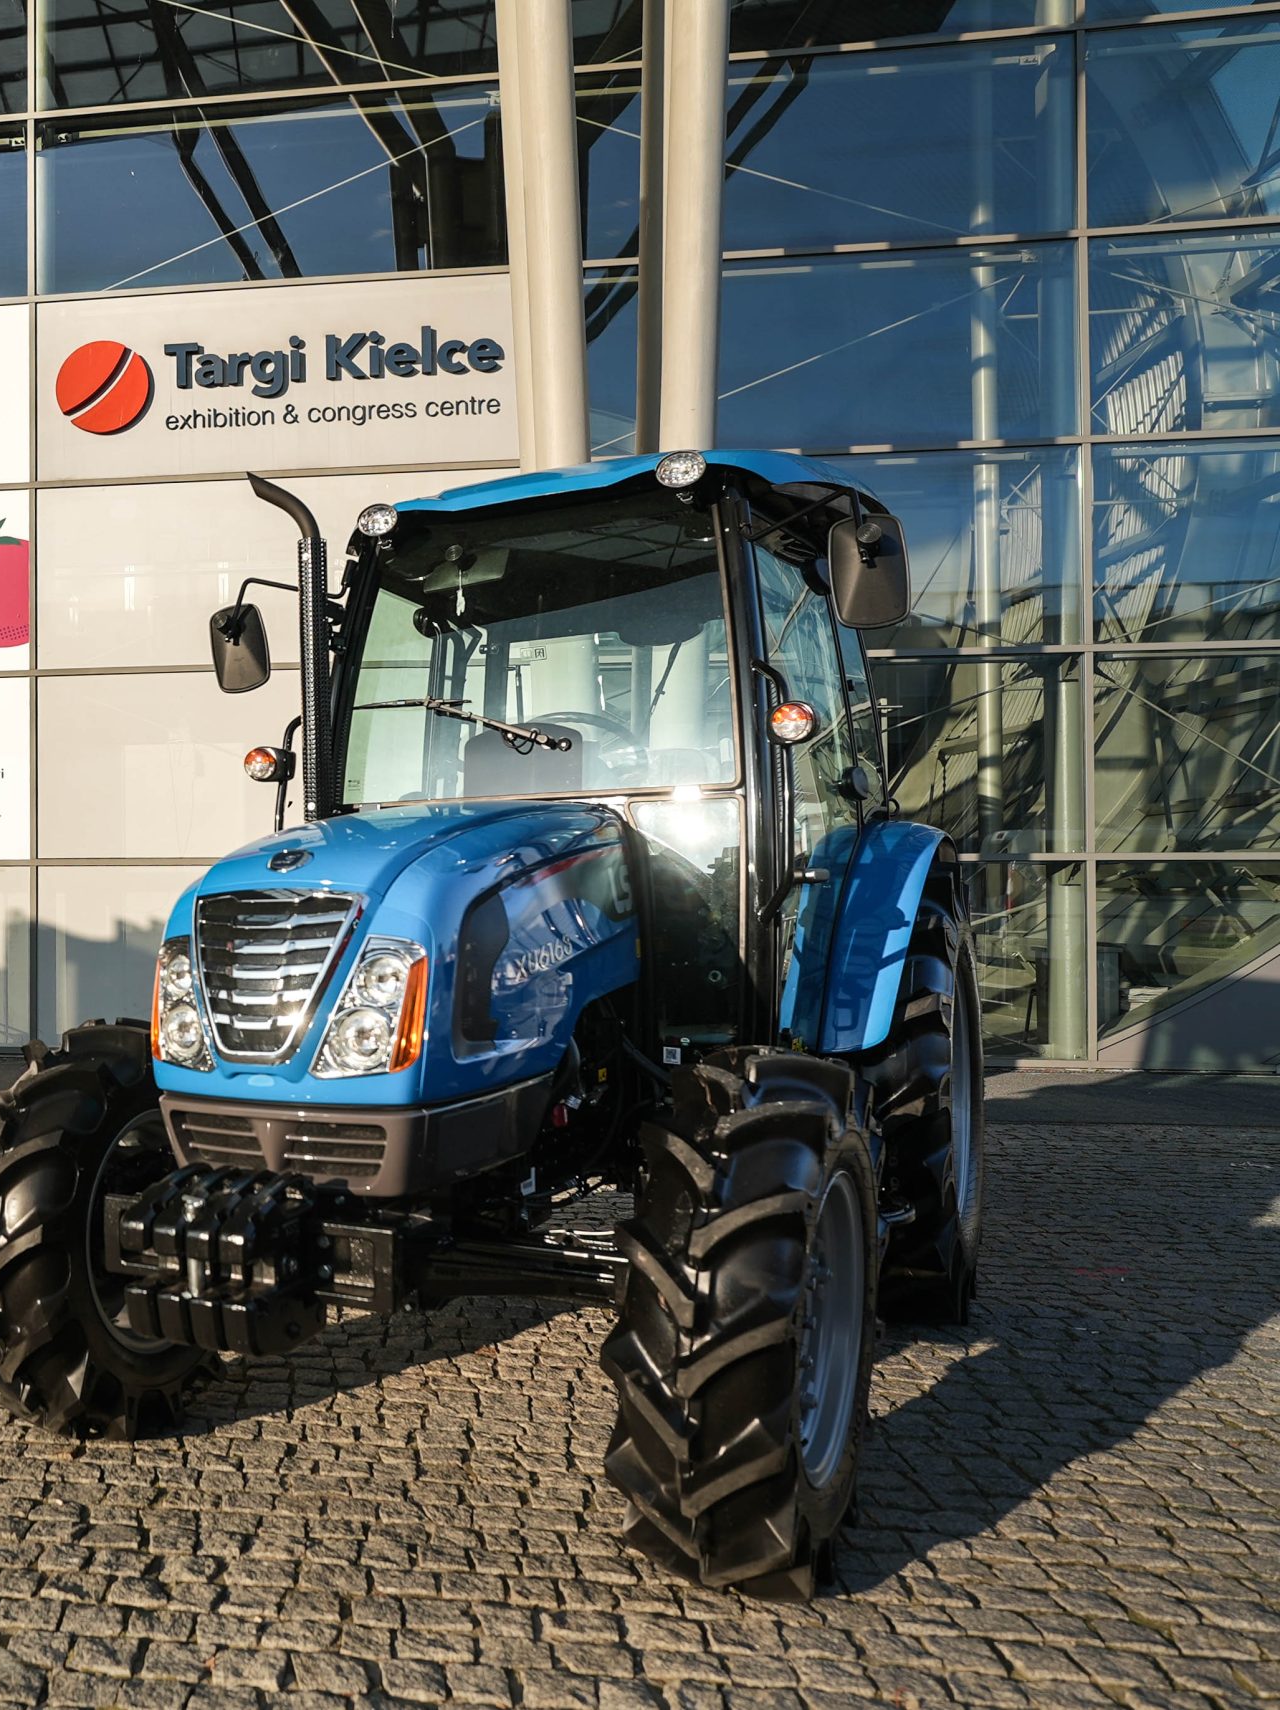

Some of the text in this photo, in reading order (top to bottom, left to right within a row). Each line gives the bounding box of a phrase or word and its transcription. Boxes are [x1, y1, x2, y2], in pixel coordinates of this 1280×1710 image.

[164, 325, 505, 399] Targi Kielce
[165, 396, 501, 430] exhibition & congress centre
